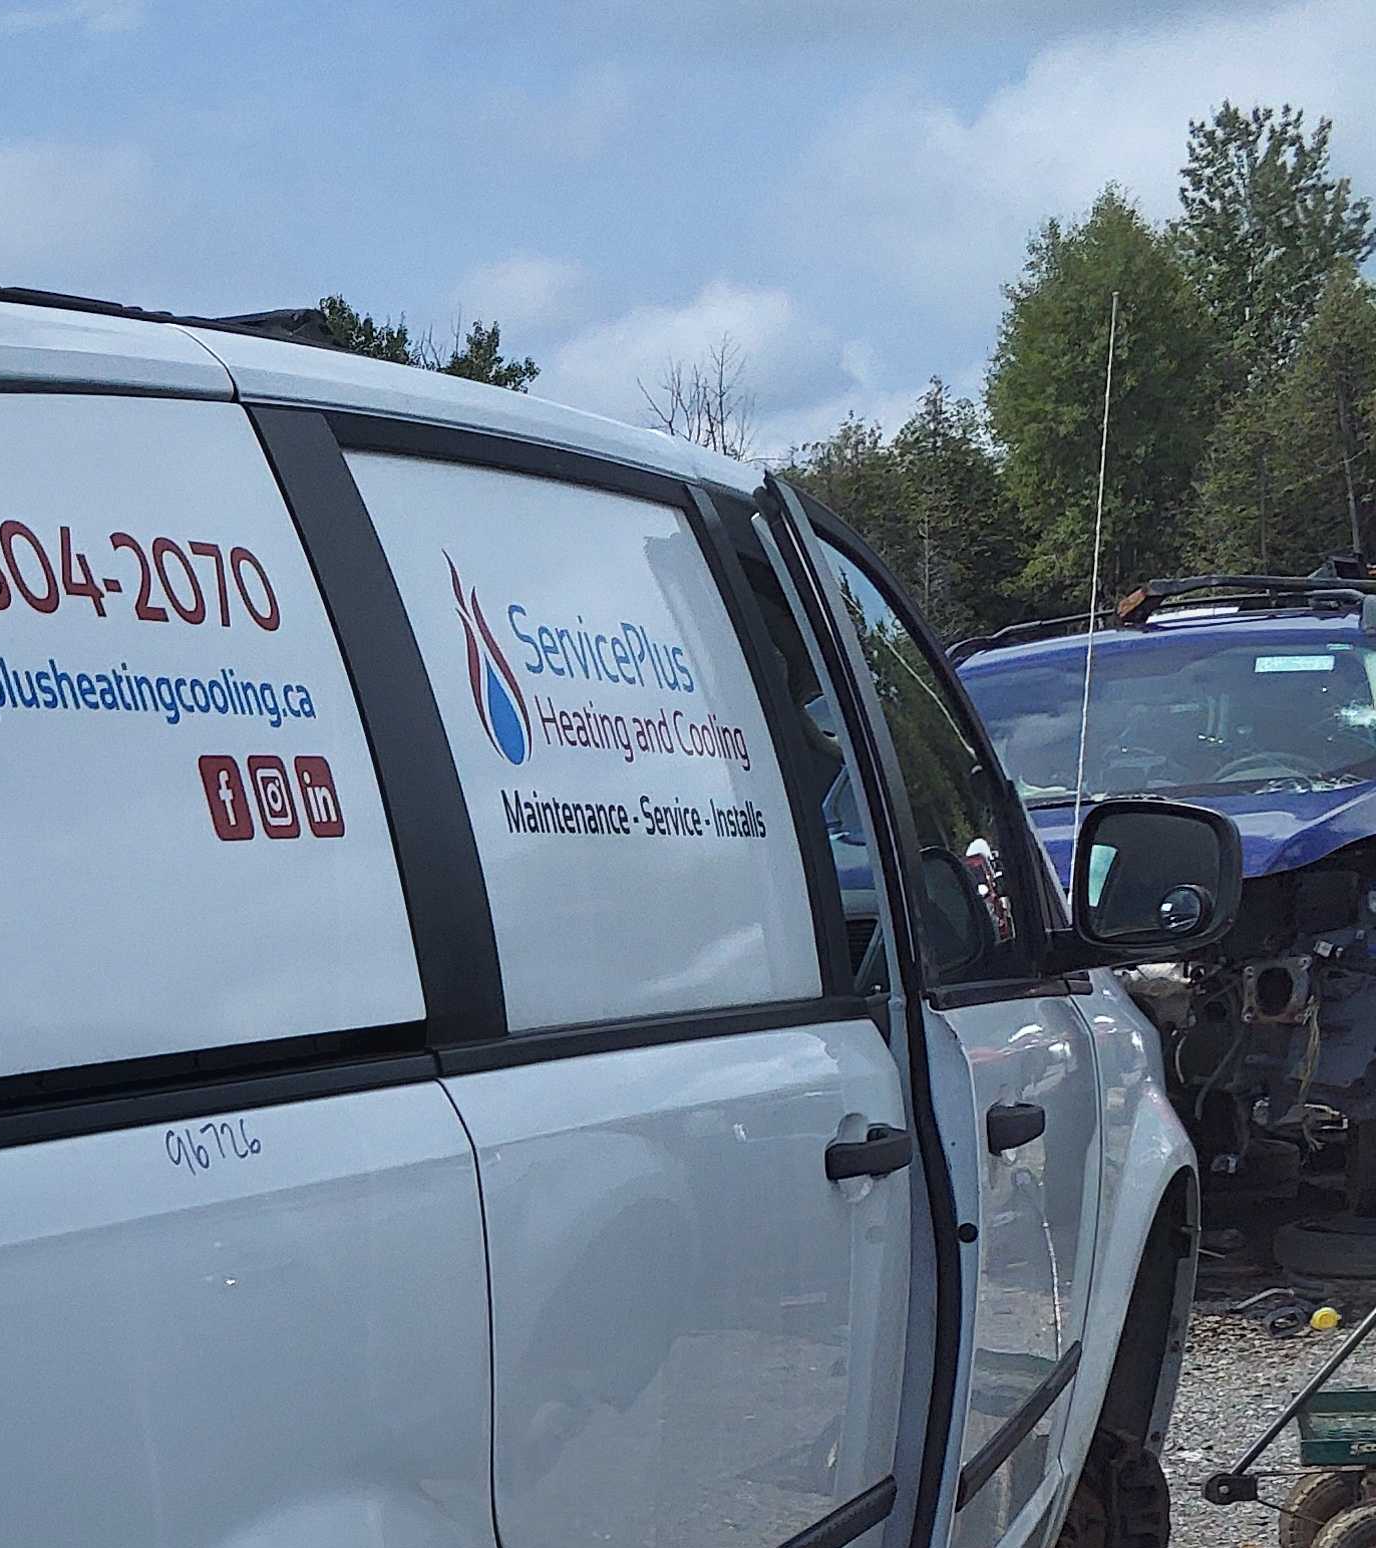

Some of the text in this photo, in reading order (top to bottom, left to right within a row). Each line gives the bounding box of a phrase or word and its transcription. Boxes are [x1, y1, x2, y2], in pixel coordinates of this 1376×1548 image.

[508, 604, 696, 694] ServicePlus
[534, 694, 751, 772] Heating and Cooling
[500, 789, 631, 835] Maintenance
[640, 795, 703, 838] Service
[710, 799, 767, 840] Installs
